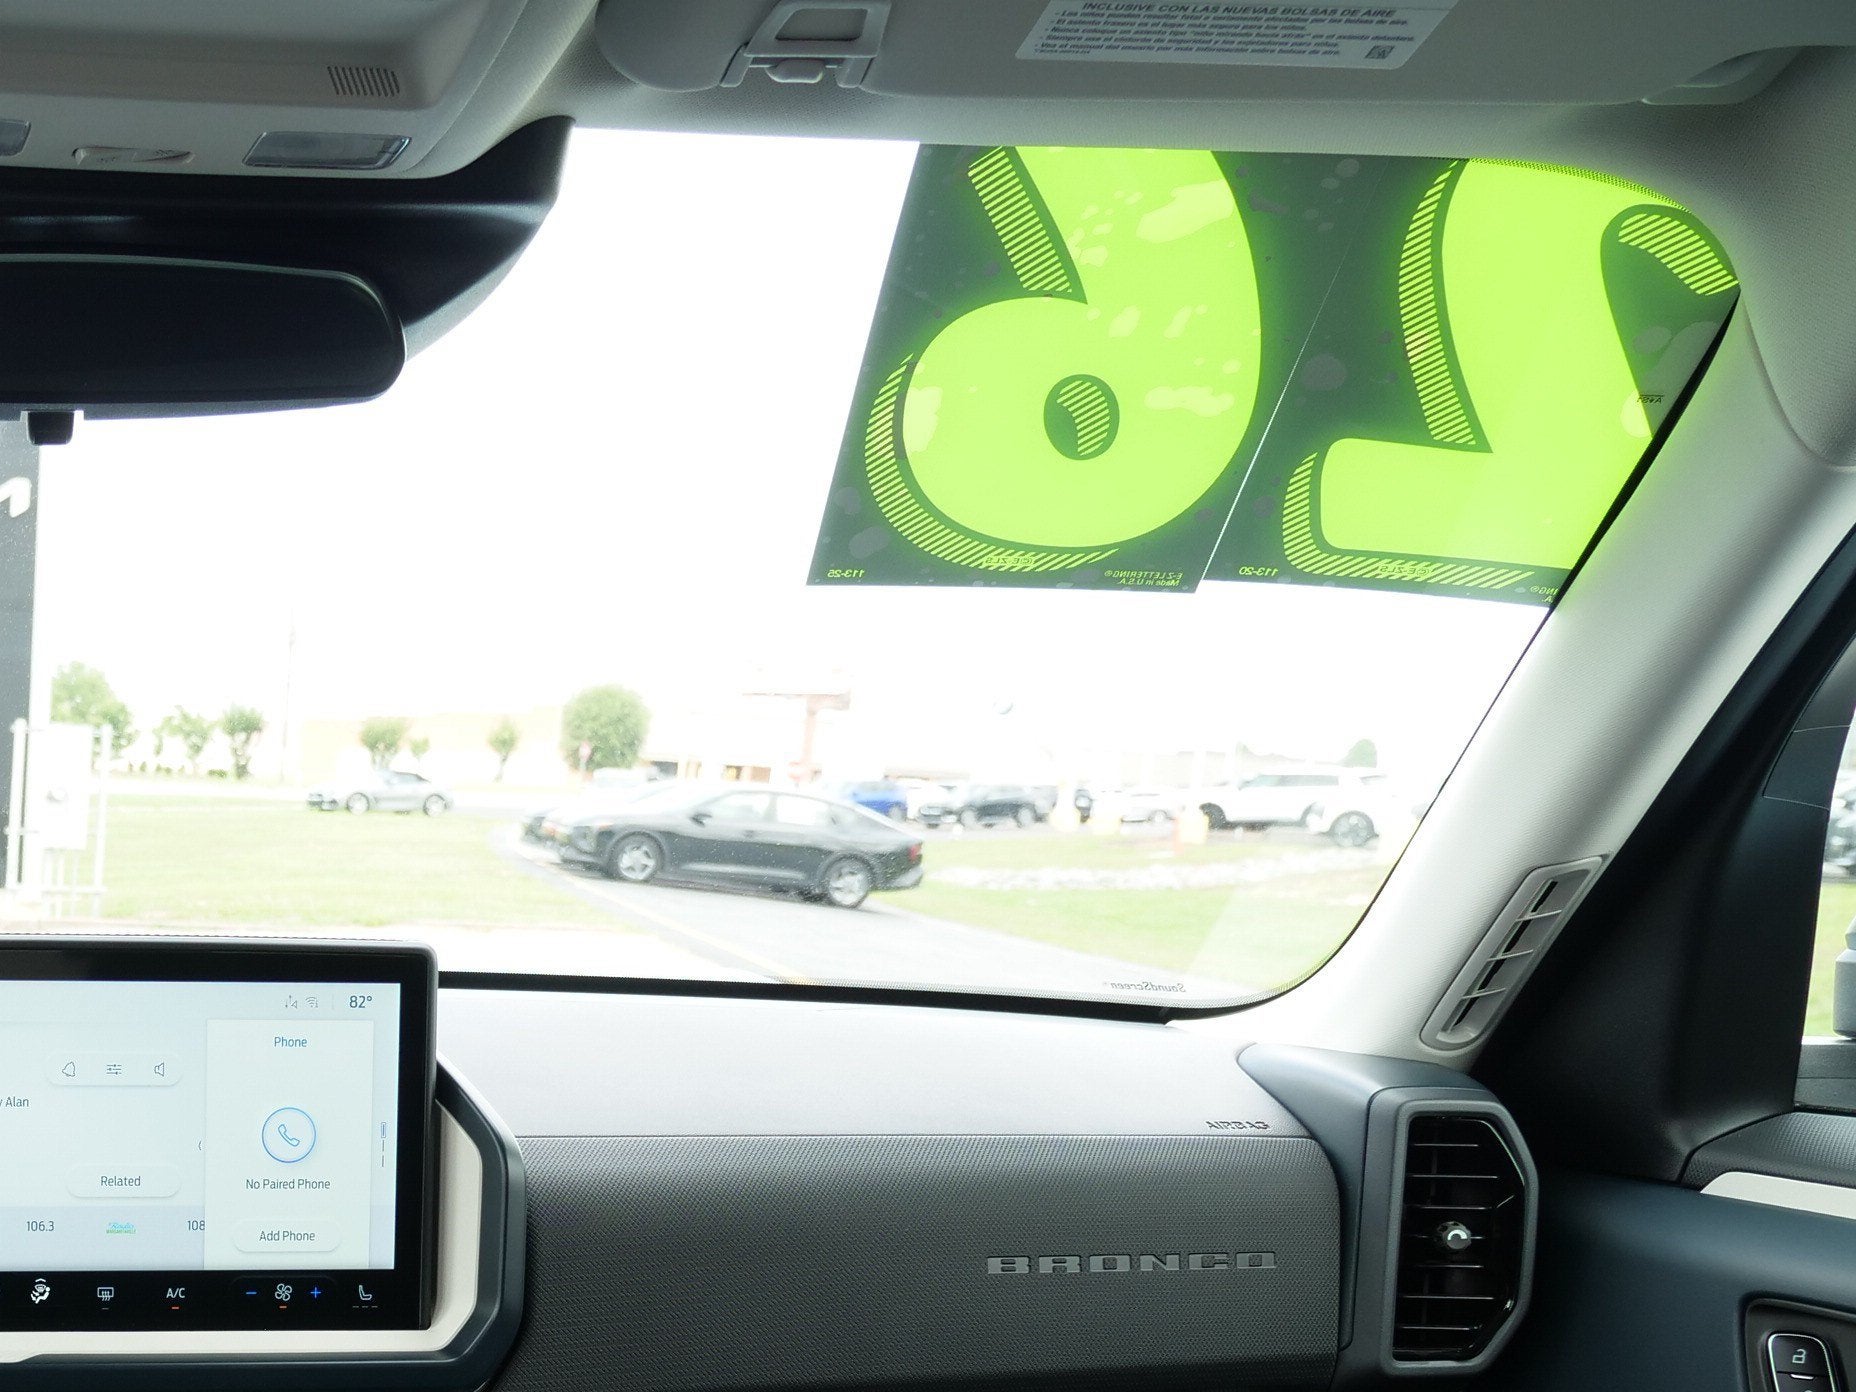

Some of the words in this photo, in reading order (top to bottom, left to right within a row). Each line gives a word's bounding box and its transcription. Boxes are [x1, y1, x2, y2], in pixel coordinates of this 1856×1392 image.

[349, 995, 373, 1009] 82°
[274, 1036, 307, 1048] Phone
[5, 1096, 29, 1108] Alan
[1205, 1120, 1270, 1130] AIRBAG
[101, 1176, 141, 1187] Related
[246, 1178, 260, 1190] No
[262, 1178, 295, 1190] Paired
[297, 1178, 331, 1190] Phone
[26, 1221, 55, 1232] 106.3
[259, 1230, 280, 1242] Add
[282, 1230, 316, 1242] Phone
[987, 1251, 1277, 1275] BRONCO
[166, 1287, 185, 1299] A/C
